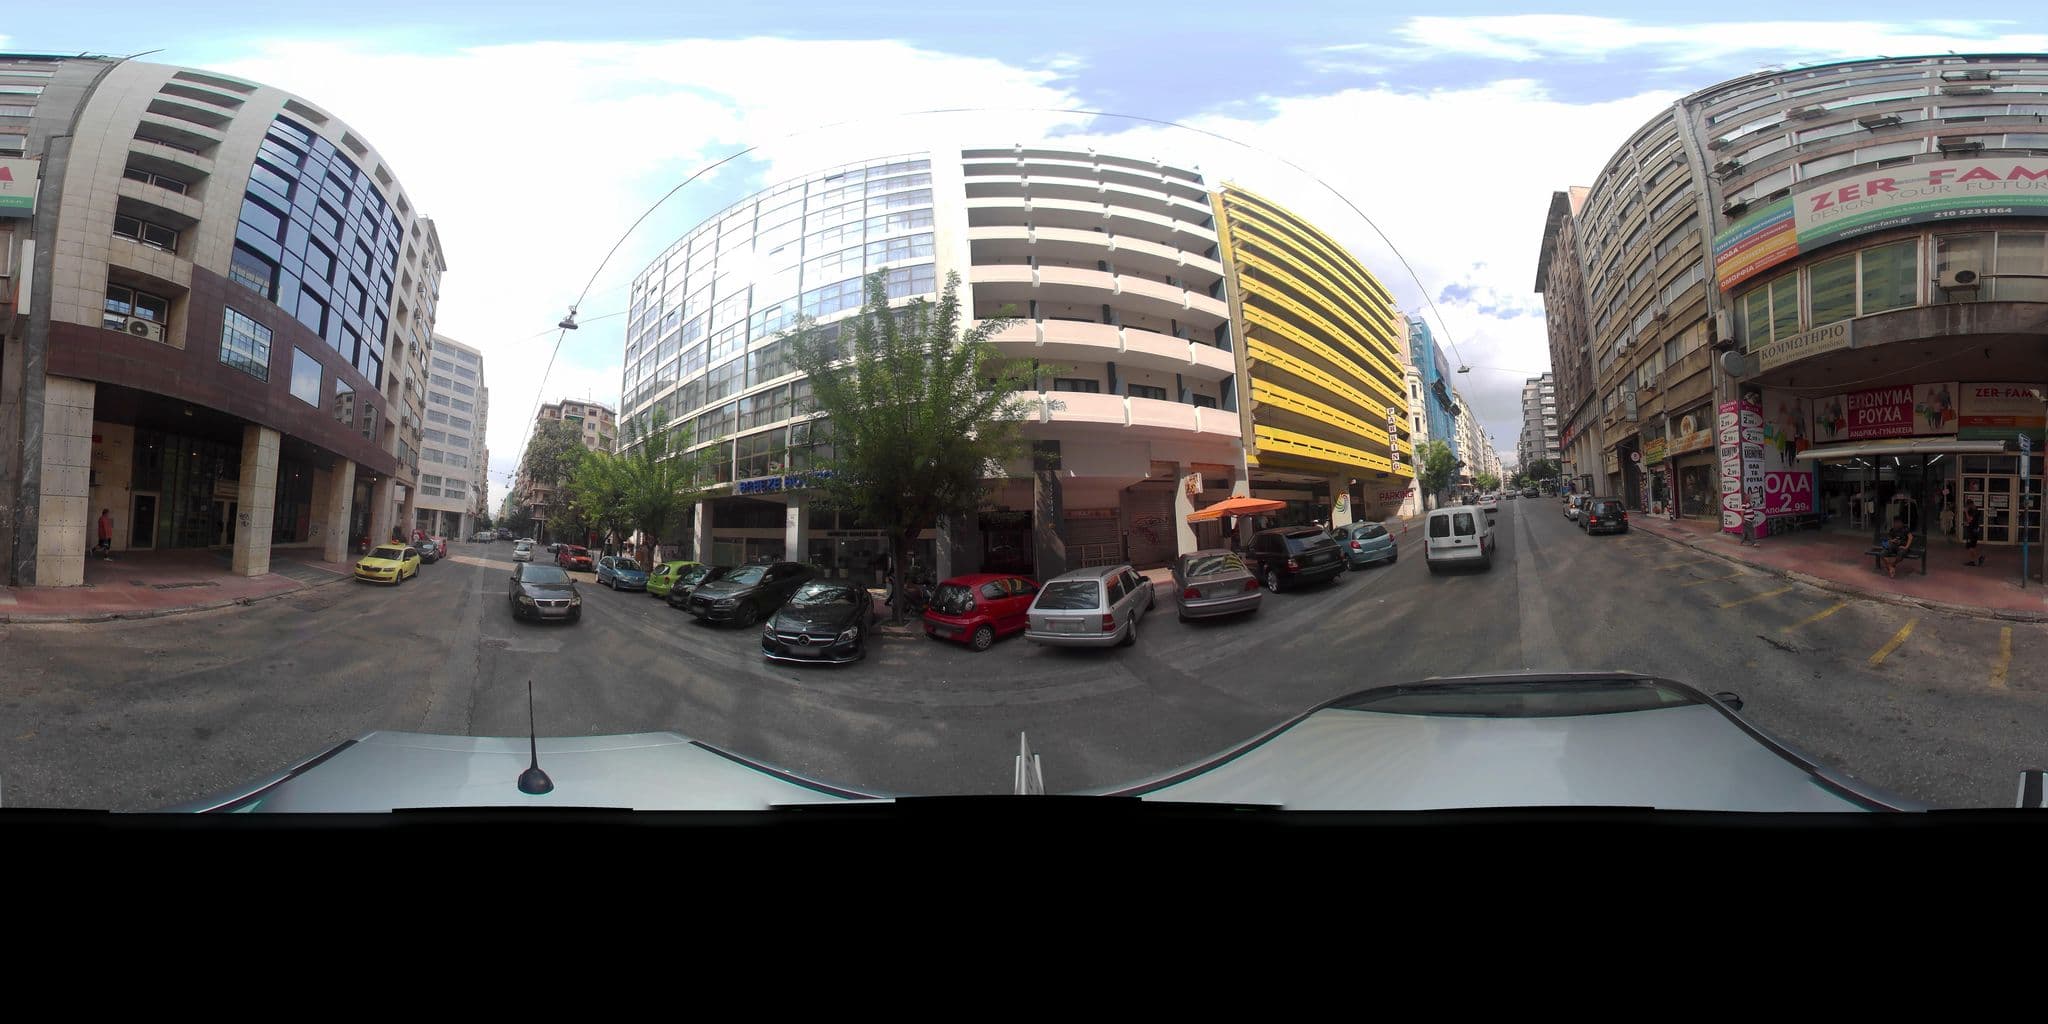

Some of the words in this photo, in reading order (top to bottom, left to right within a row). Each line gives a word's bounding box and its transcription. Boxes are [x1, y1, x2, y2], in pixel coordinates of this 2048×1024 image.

[1811, 197, 1874, 222] DESIGN
[1888, 184, 1951, 200] YOUR
[1840, 217, 1911, 237] www.zer-fam.gr
[1761, 324, 1845, 360] ΚΟΜΜΩΤΗΡΙΟ
[1848, 388, 1912, 410] ΕΠΩΝΥΜΑ
[1858, 406, 1902, 424] ΡΟΥΧΑ
[1387, 408, 1400, 470] PARKING
[1765, 473, 1810, 494] ΟΛΑ
[1379, 489, 1413, 500] PARKING
